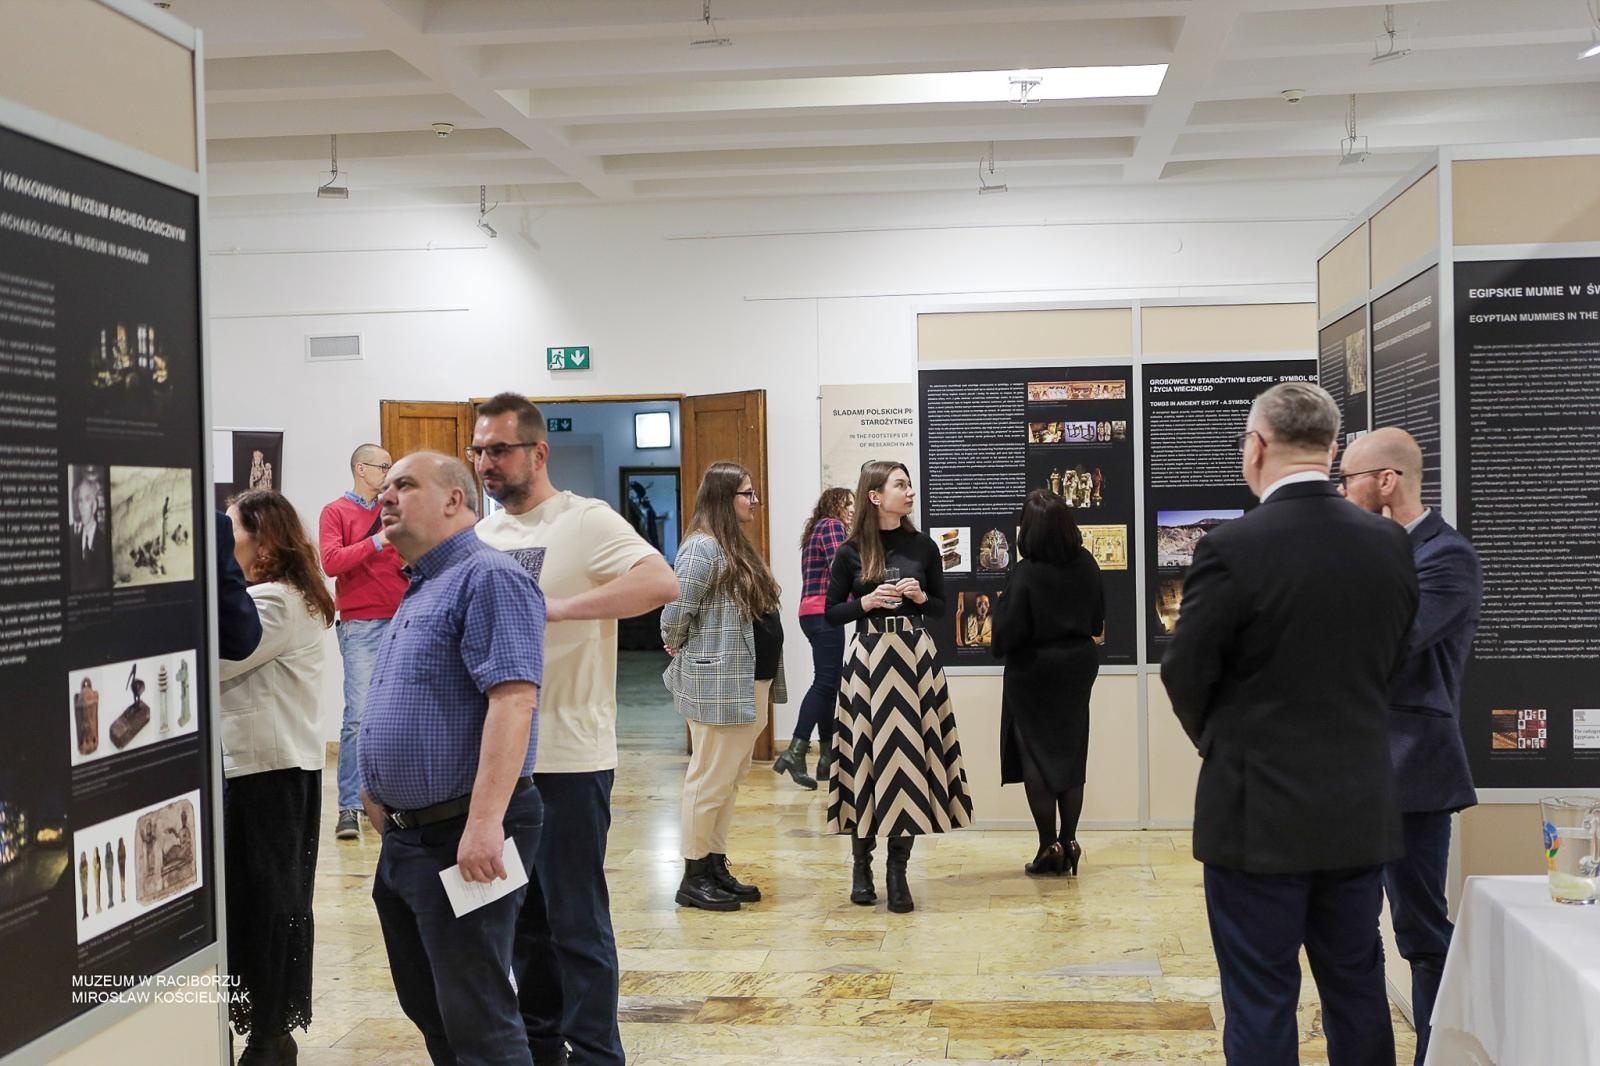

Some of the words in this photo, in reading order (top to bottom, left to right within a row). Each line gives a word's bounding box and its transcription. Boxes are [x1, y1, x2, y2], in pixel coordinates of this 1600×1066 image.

[3, 171, 70, 208] KRAKOWSKIM
[71, 193, 109, 219] MUZEUM
[109, 206, 186, 242] ARCHEOLOGICZNYM
[0, 212, 73, 246] RCHAEOLOGICAL
[74, 232, 107, 255] MUSEUM
[108, 243, 116, 257] IN
[1469, 287, 1523, 298] EGIPSKIE
[1525, 286, 1564, 297] MUMIE
[1569, 285, 1581, 296] W
[1469, 313, 1517, 323] EGYPTIAN
[1519, 312, 1565, 322] MUMMIES
[1567, 311, 1577, 320] IN
[1579, 311, 1599, 320] THE
[1149, 378, 1189, 386] GROBOWCE
[1197, 376, 1246, 385] STAROŻYTNYM
[1153, 385, 1173, 393] ŻYCIA
[833, 408, 865, 417] ŚLADAMI
[866, 408, 903, 416] POLSKICH
